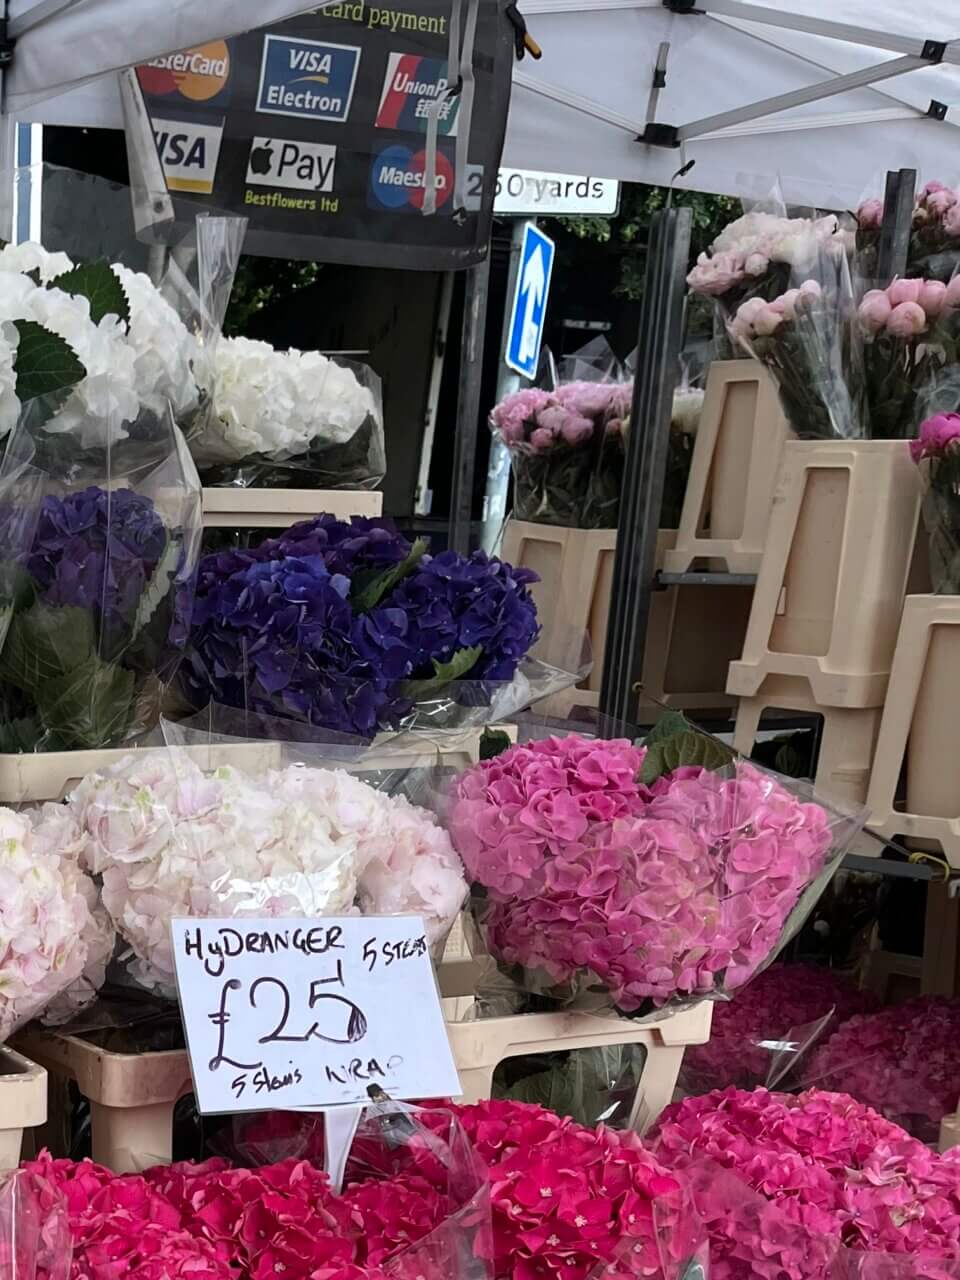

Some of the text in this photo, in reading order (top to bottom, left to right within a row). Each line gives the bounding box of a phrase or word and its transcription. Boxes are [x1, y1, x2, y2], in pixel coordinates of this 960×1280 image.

[368, 7, 447, 34] payment
[148, 53, 227, 77] sterCard
[289, 49, 333, 73] VISA
[266, 85, 341, 112] Electron
[393, 72, 457, 107] UnionP
[154, 131, 206, 169] ISA
[277, 143, 334, 190] Pay
[379, 166, 446, 189] Maeso
[245, 190, 316, 211] Bestflowers
[529, 176, 604, 202] yards
[362, 936, 378, 972] 5
[208, 959, 368, 1072] £25
